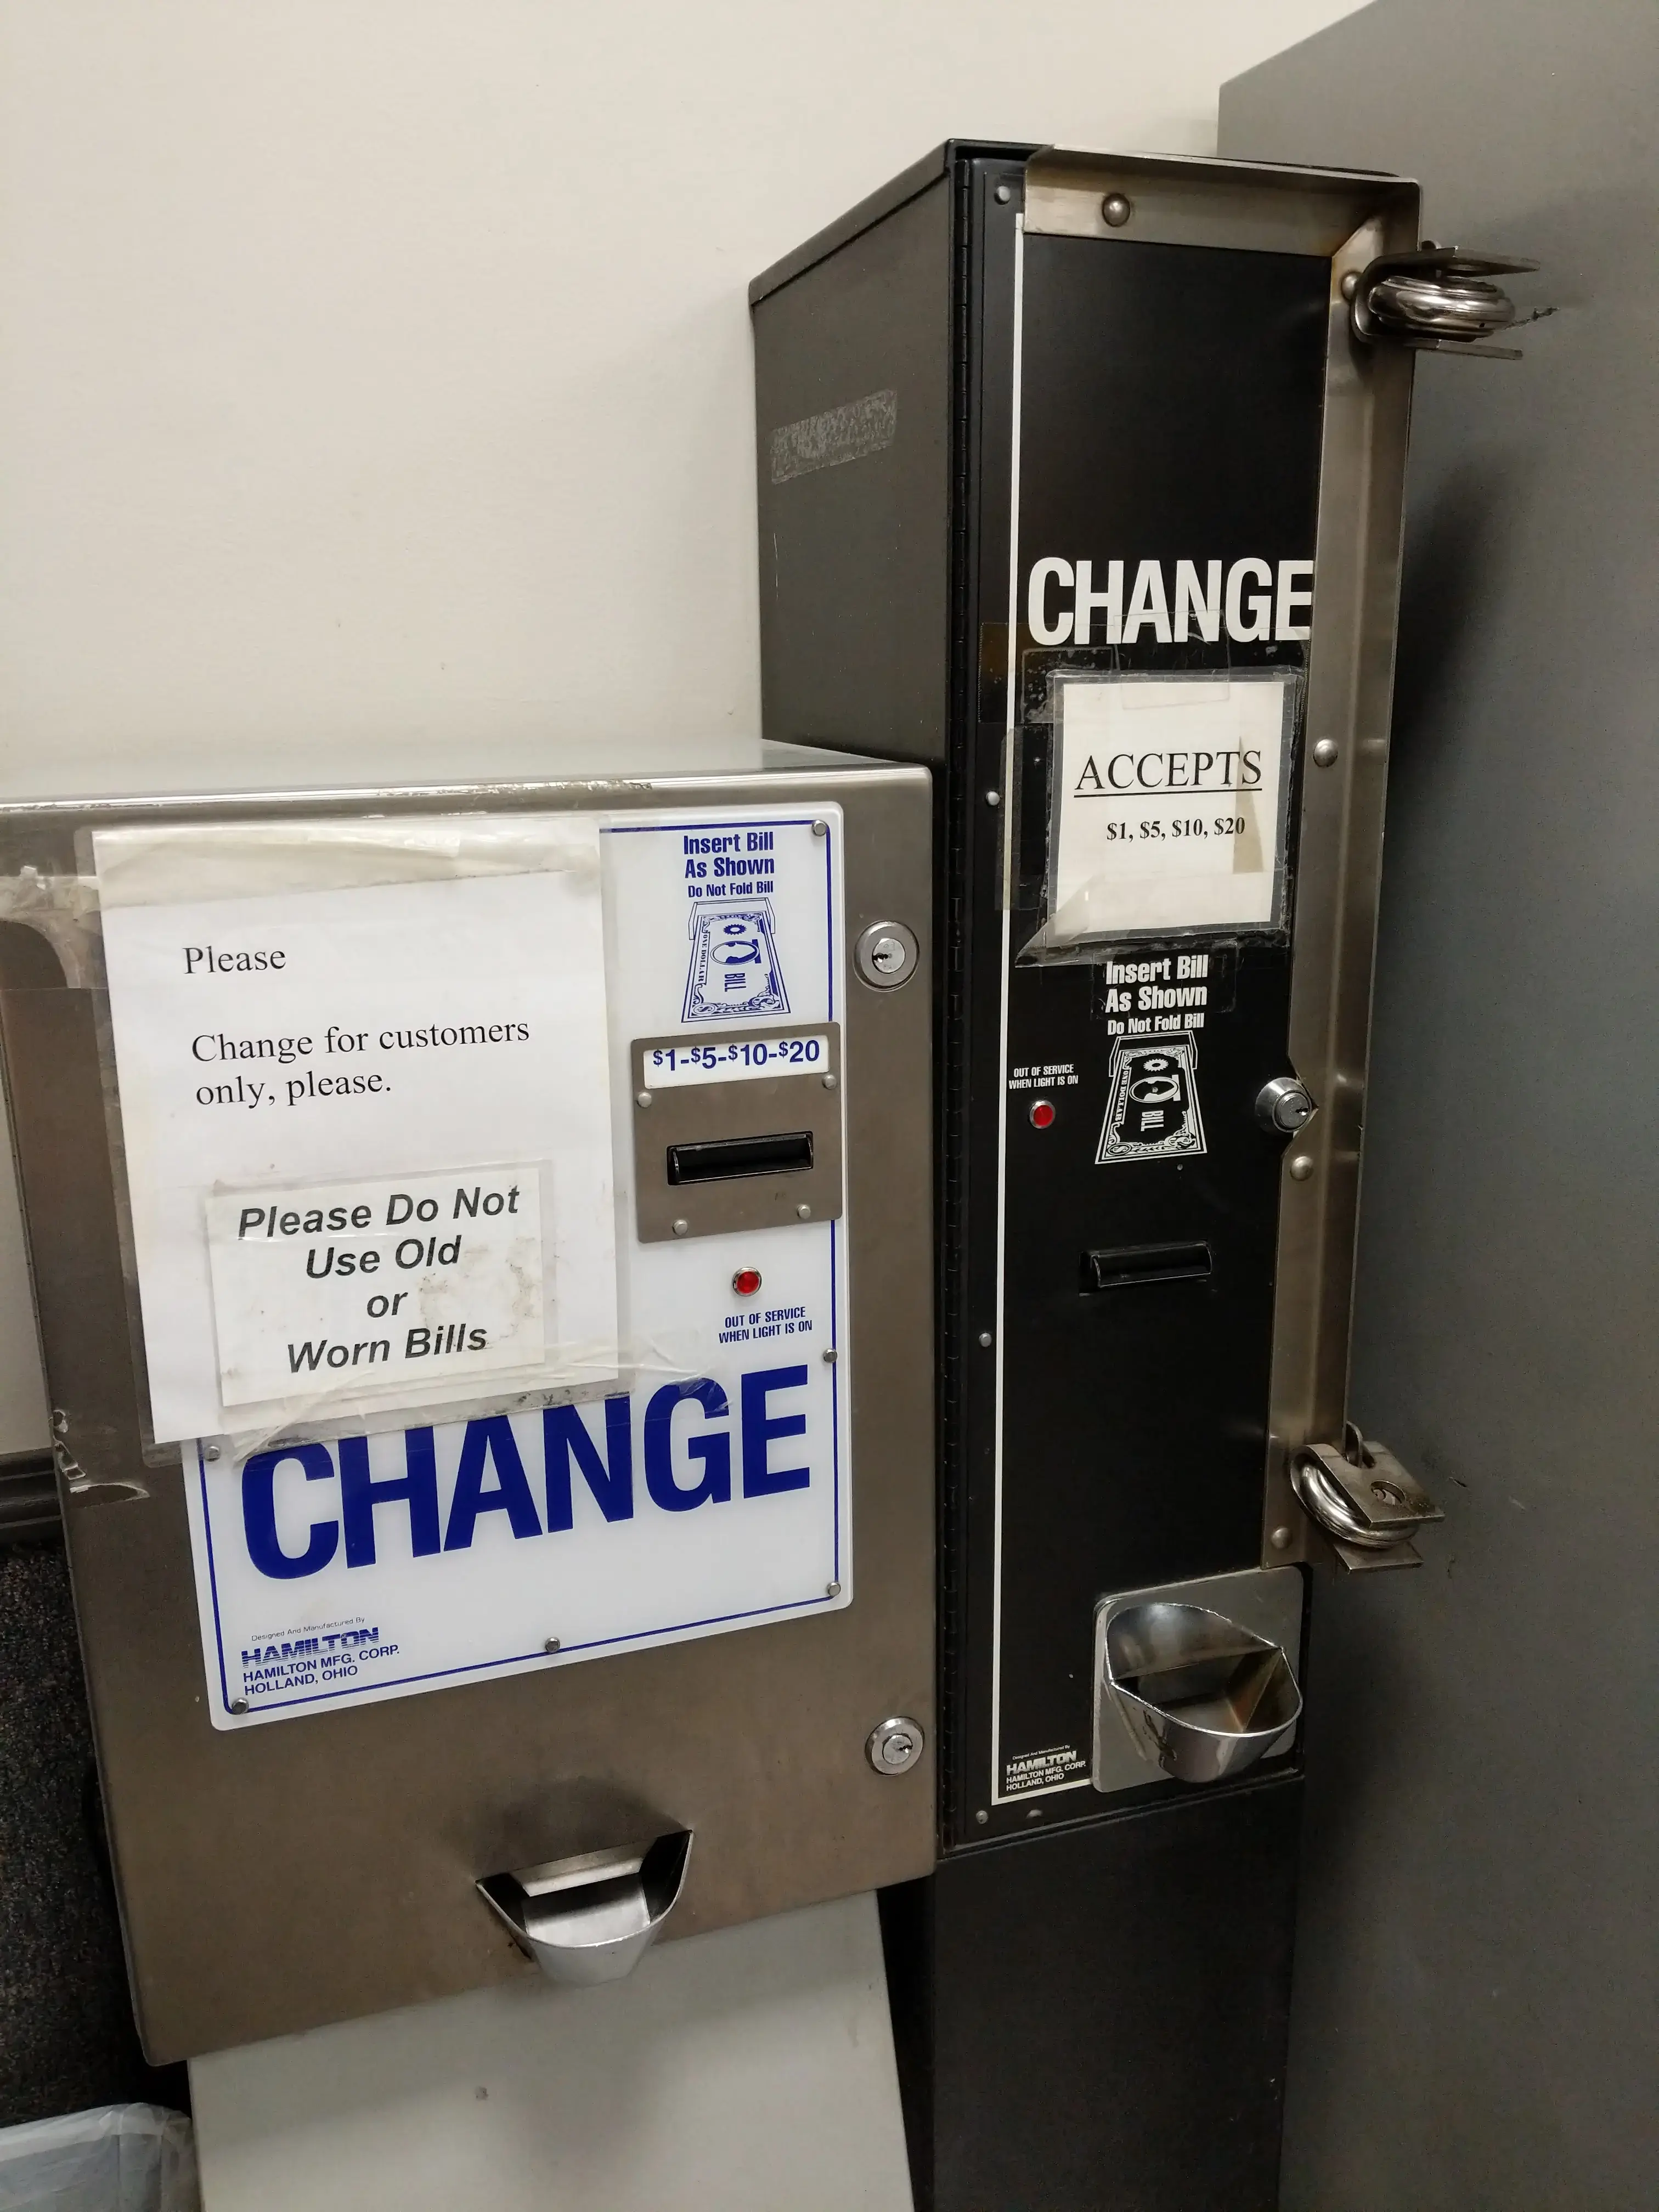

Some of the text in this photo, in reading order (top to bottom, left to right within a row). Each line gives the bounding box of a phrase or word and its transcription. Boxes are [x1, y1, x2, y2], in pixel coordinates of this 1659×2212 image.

[1029, 557, 1313, 645] CHANGE
[1075, 751, 1261, 789] ACCEPTS
[1107, 817, 1245, 842] $1, $5, $10, $20
[684, 832, 773, 854] Insert Bill
[685, 857, 774, 878] As Shown
[689, 881, 773, 898] Do Not Fold Bill
[183, 946, 285, 974] Please
[1106, 955, 1208, 984] Insert Bill
[725, 973, 746, 992] BILL
[1105, 986, 1207, 1013] As Shown
[1108, 1013, 1204, 1035] Do Not Fold Bill
[193, 1024, 529, 1063] Change for customers
[653, 1040, 820, 1072] $1-$5-$10-$20
[1009, 1075, 1078, 1089] WHEN LIGHT IS ON
[1014, 1064, 1074, 1077] OUT OF SERVICE
[197, 1071, 390, 1109] only, please.
[1141, 1110, 1164, 1131] BILL
[239, 1186, 520, 1240] Please Do Not
[307, 1235, 461, 1278] Use Old
[367, 1293, 408, 1318] or
[725, 1307, 805, 1328] OUT OF SERVICE
[719, 1320, 812, 1343] WHEN LIGHT IS ON
[288, 1323, 487, 1373] Worn Bills
[241, 1364, 810, 1579] CHANGE
[252, 1632, 284, 1641] Designed
[304, 1620, 353, 1631] Manufactured
[240, 1627, 380, 1669] HAMILTON
[242, 1645, 399, 1683] HAMILTON MFG. CORP.
[244, 1666, 357, 1695] HOLLAND, OHIO
[1006, 1751, 1077, 1775] HAMILTON
[1007, 1761, 1086, 1784] HAMILTON MFG. CORP.
[1007, 1773, 1064, 1791] HOLLAND, OHIO
